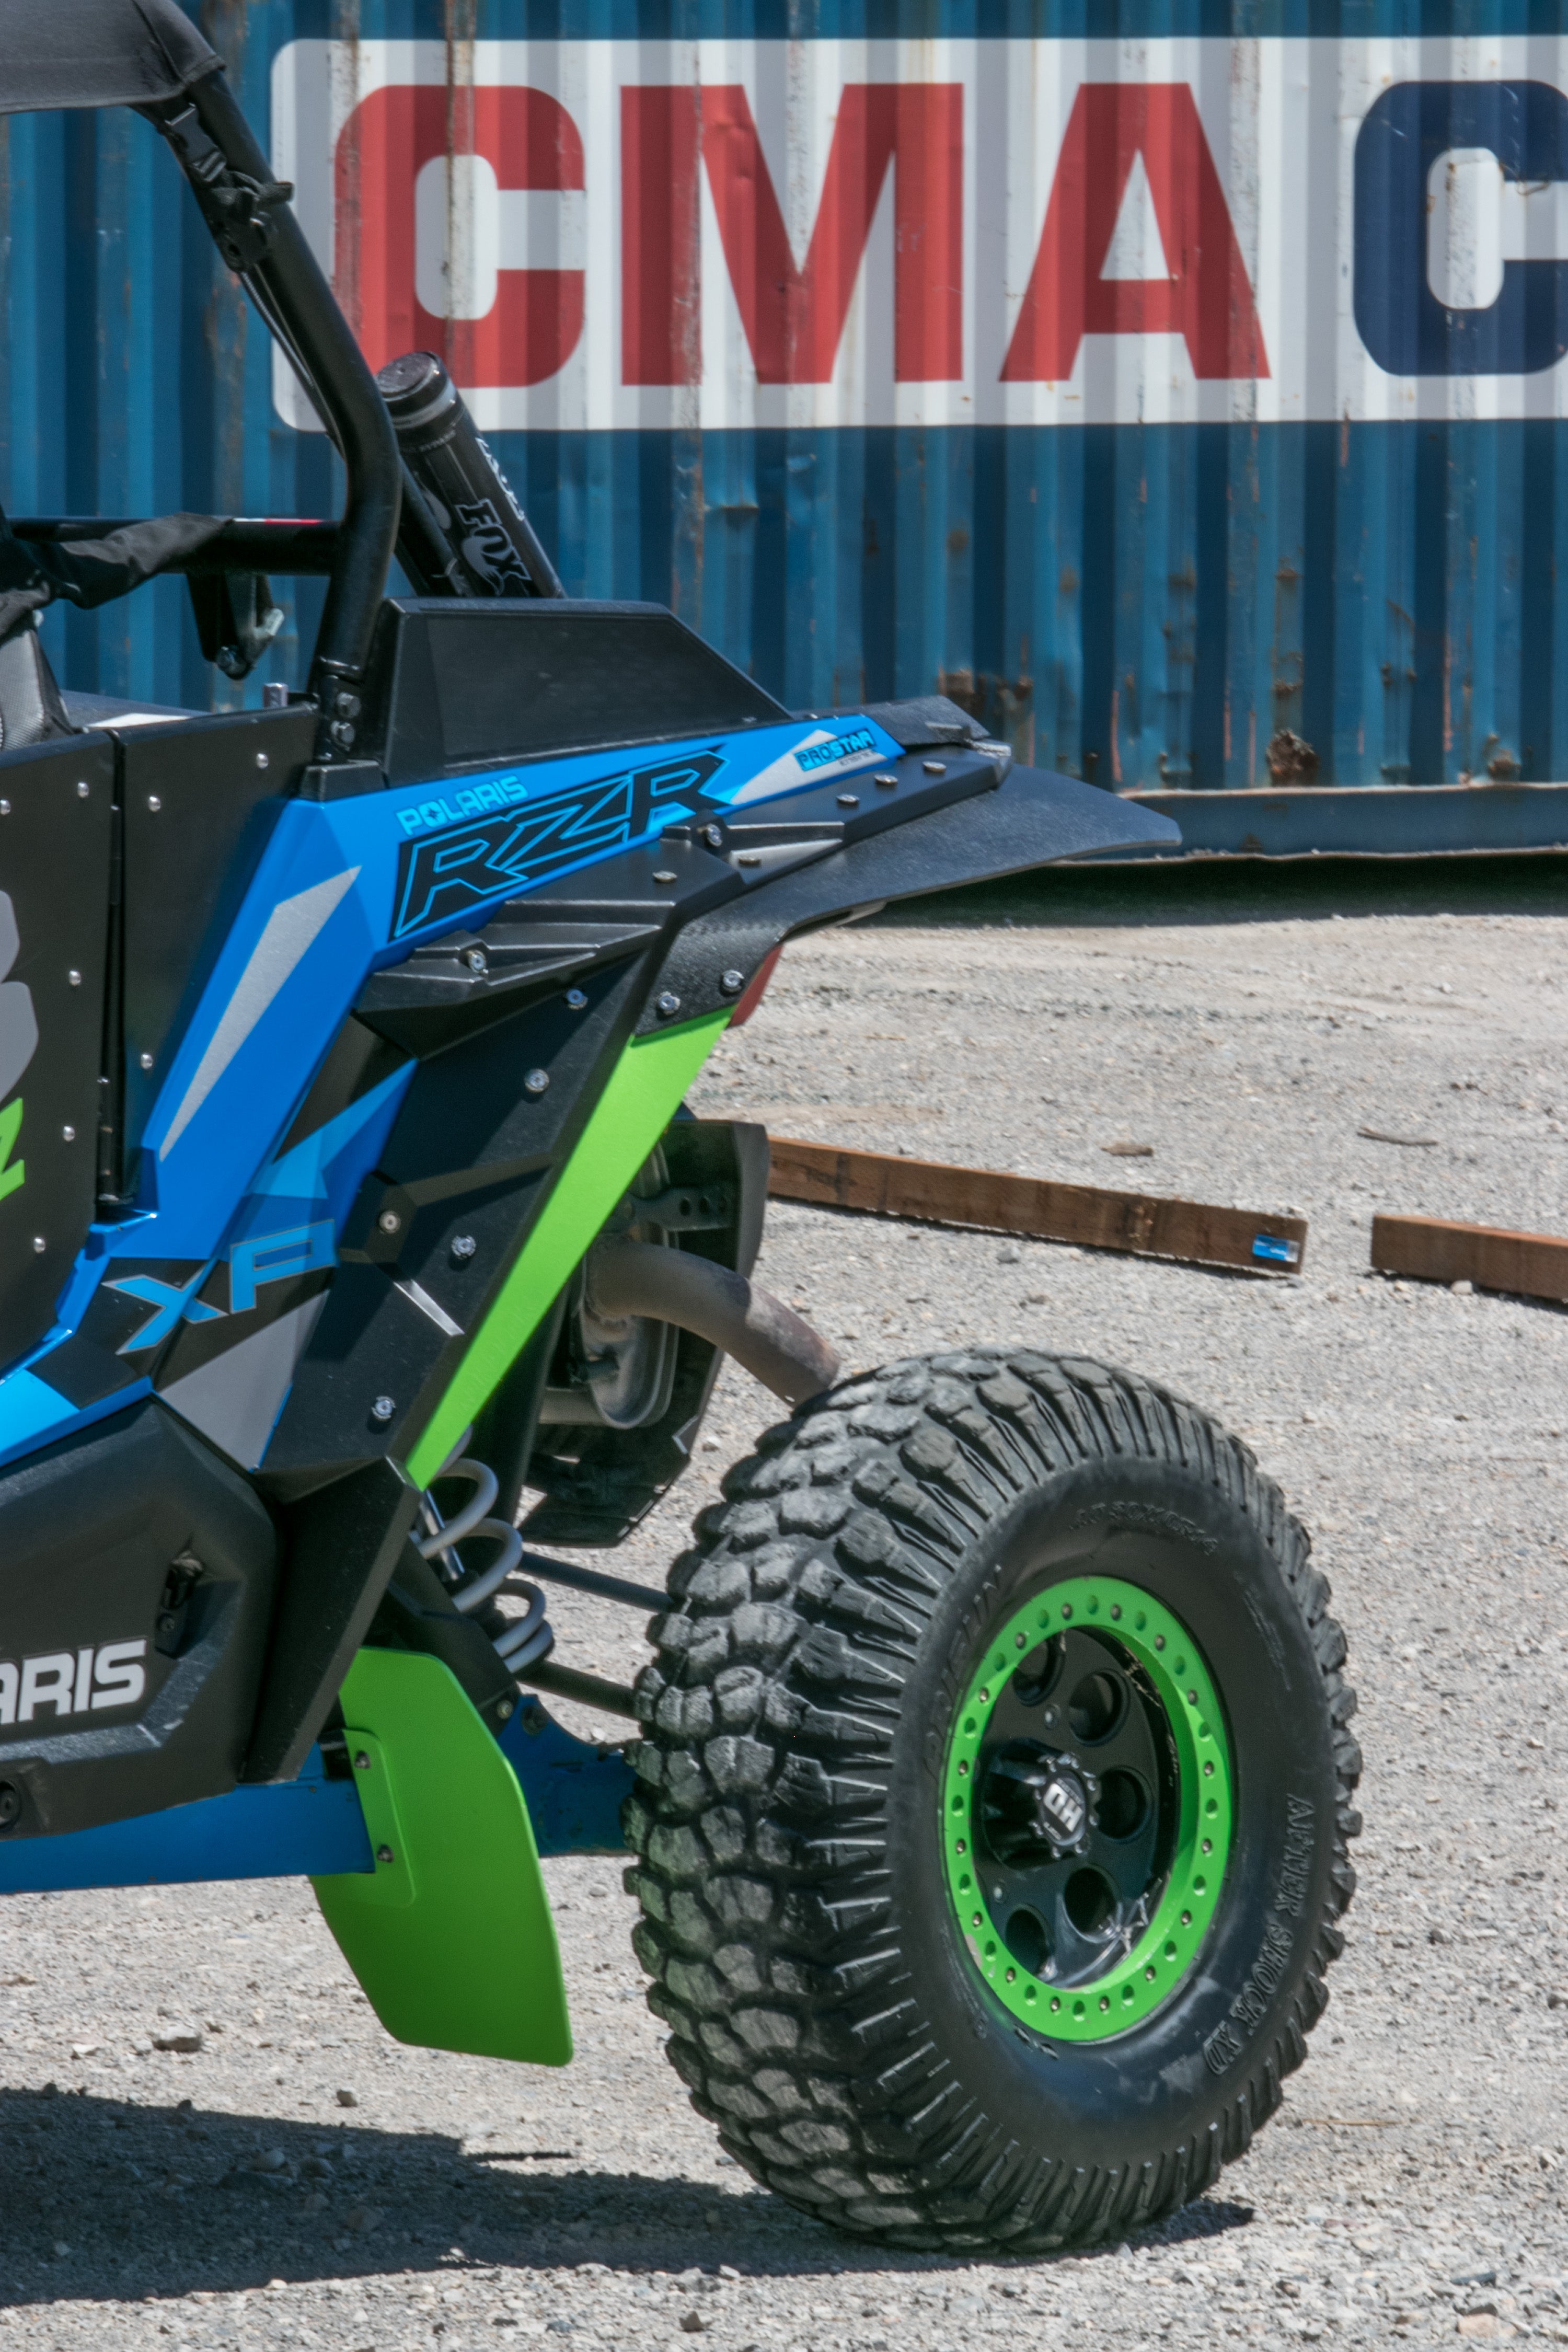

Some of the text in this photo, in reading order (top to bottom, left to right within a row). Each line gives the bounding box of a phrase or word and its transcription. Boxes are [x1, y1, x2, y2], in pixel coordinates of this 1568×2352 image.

[335, 79, 1568, 388] CMA C
[454, 498, 532, 581] FOX
[396, 775, 528, 836] POLARIS
[796, 729, 875, 770] PROSTAR
[394, 750, 737, 939] RZR
[101, 1219, 336, 1355] XP
[1275, 1793, 1314, 1917] AFTER
[1230, 1923, 1295, 2036] SHOCK
